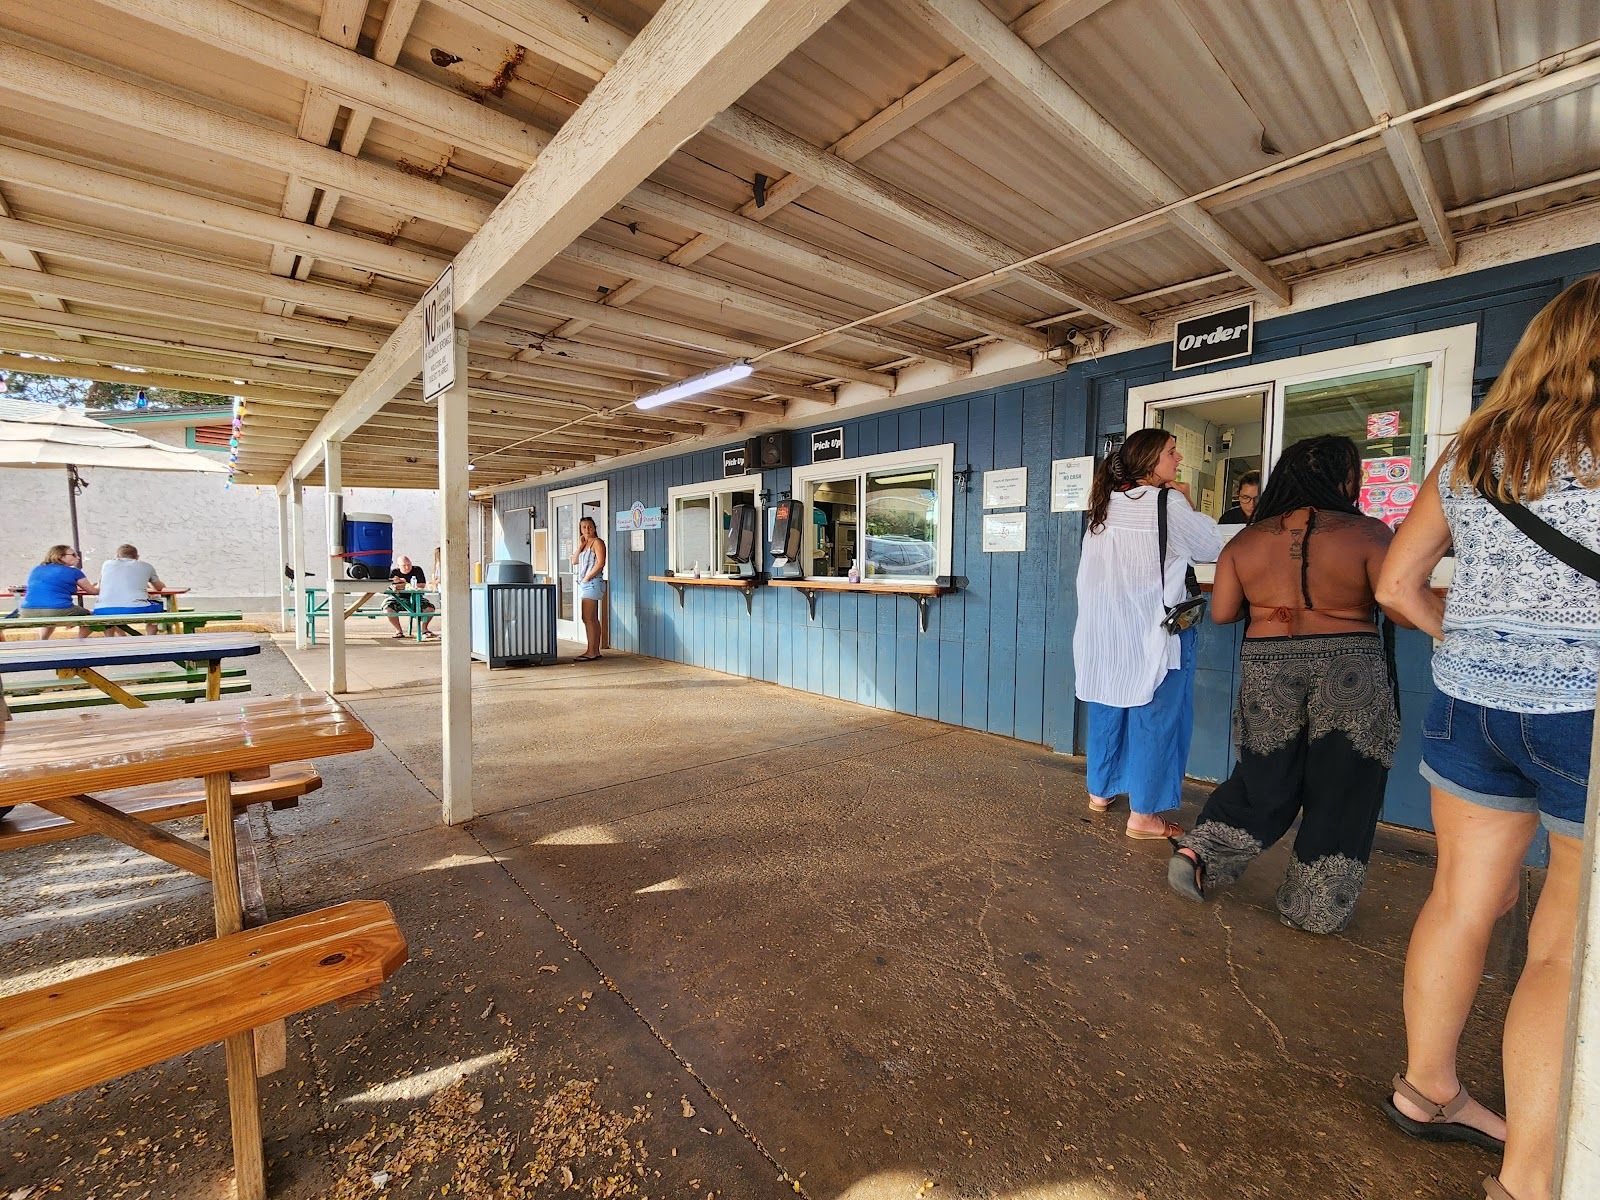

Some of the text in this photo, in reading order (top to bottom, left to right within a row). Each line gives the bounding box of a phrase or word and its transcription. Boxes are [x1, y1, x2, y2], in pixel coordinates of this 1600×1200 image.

[425, 299, 437, 347] NO
[1178, 323, 1249, 352] Order
[814, 438, 842, 451] Pick Up
[725, 457, 745, 467] Pick Up
